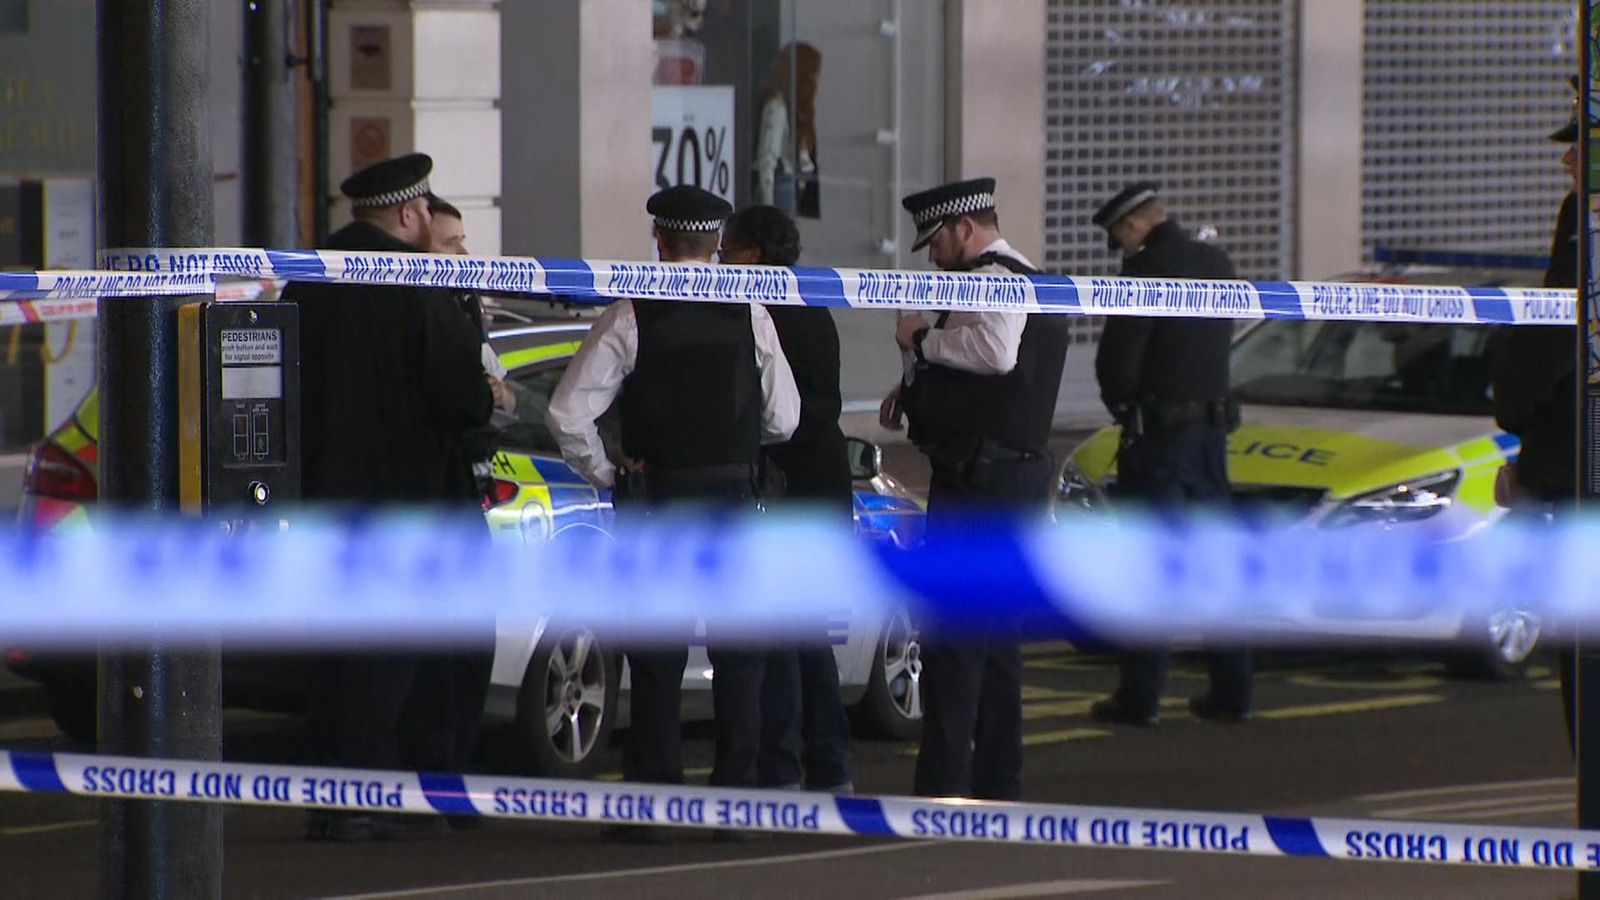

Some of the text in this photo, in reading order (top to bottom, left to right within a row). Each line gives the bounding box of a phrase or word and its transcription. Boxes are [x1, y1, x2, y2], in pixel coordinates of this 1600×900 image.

[342, 256, 536, 290] POLICE LINE DO NOT CROSS
[608, 264, 789, 300] POLICE LINE DO NOT CROSS
[857, 272, 1026, 308] POLICE LINE DO NOT CROSS
[1091, 279, 1250, 313] POLICE LINE DO NOT CROSS
[1312, 285, 1465, 318] POLICE LINE DO NOT CROSS
[1523, 290, 1560, 319] POLICE
[222, 331, 277, 341] PEDESTRIANS
[83, 765, 403, 808] POLICE DO NOT CROSS
[493, 786, 820, 830] POLICE DO NOT CROSS
[912, 808, 1250, 852] POLICE DO NOT CROSS
[1345, 829, 1448, 862] CROSS
[1463, 835, 1520, 865] NOT
[1531, 839, 1575, 868] DO
